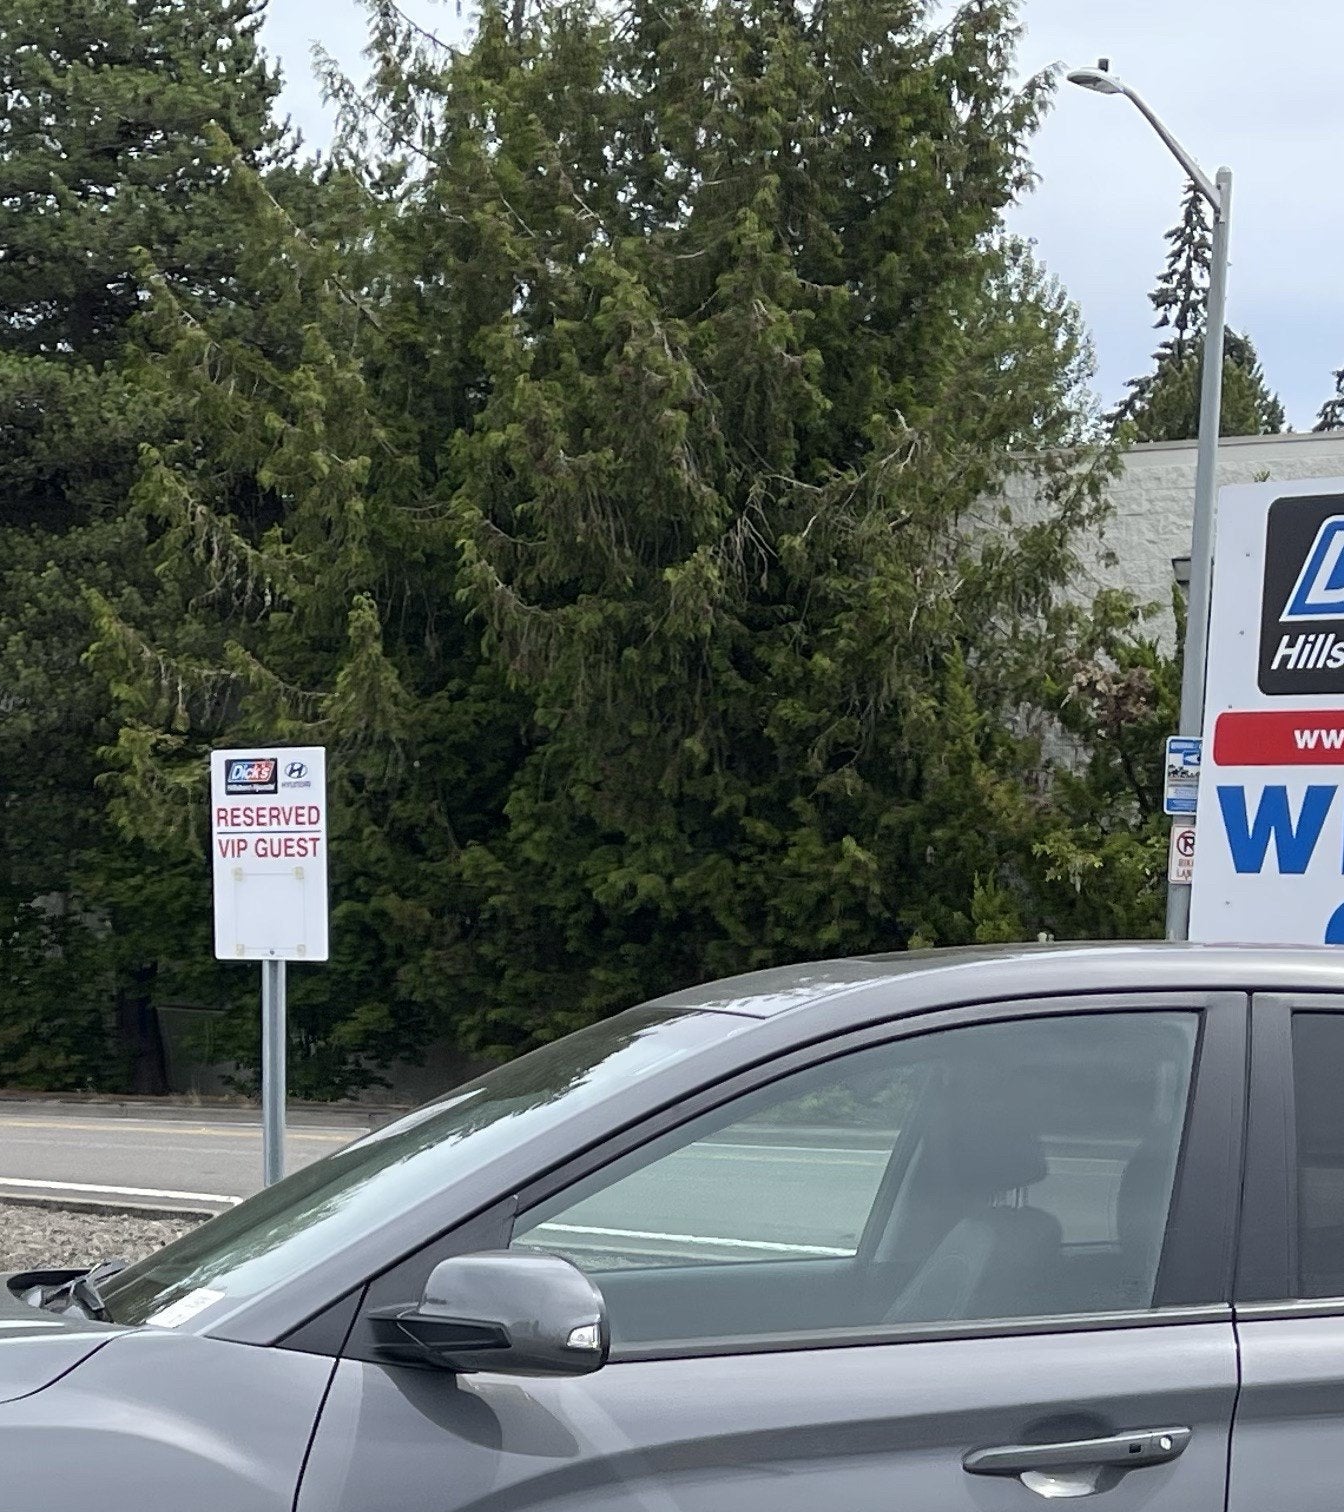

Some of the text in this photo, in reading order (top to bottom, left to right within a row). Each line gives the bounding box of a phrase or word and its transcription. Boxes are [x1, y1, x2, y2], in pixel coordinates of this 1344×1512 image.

[217, 806, 320, 827] RESERVED
[218, 837, 321, 858] VIP GUEST
